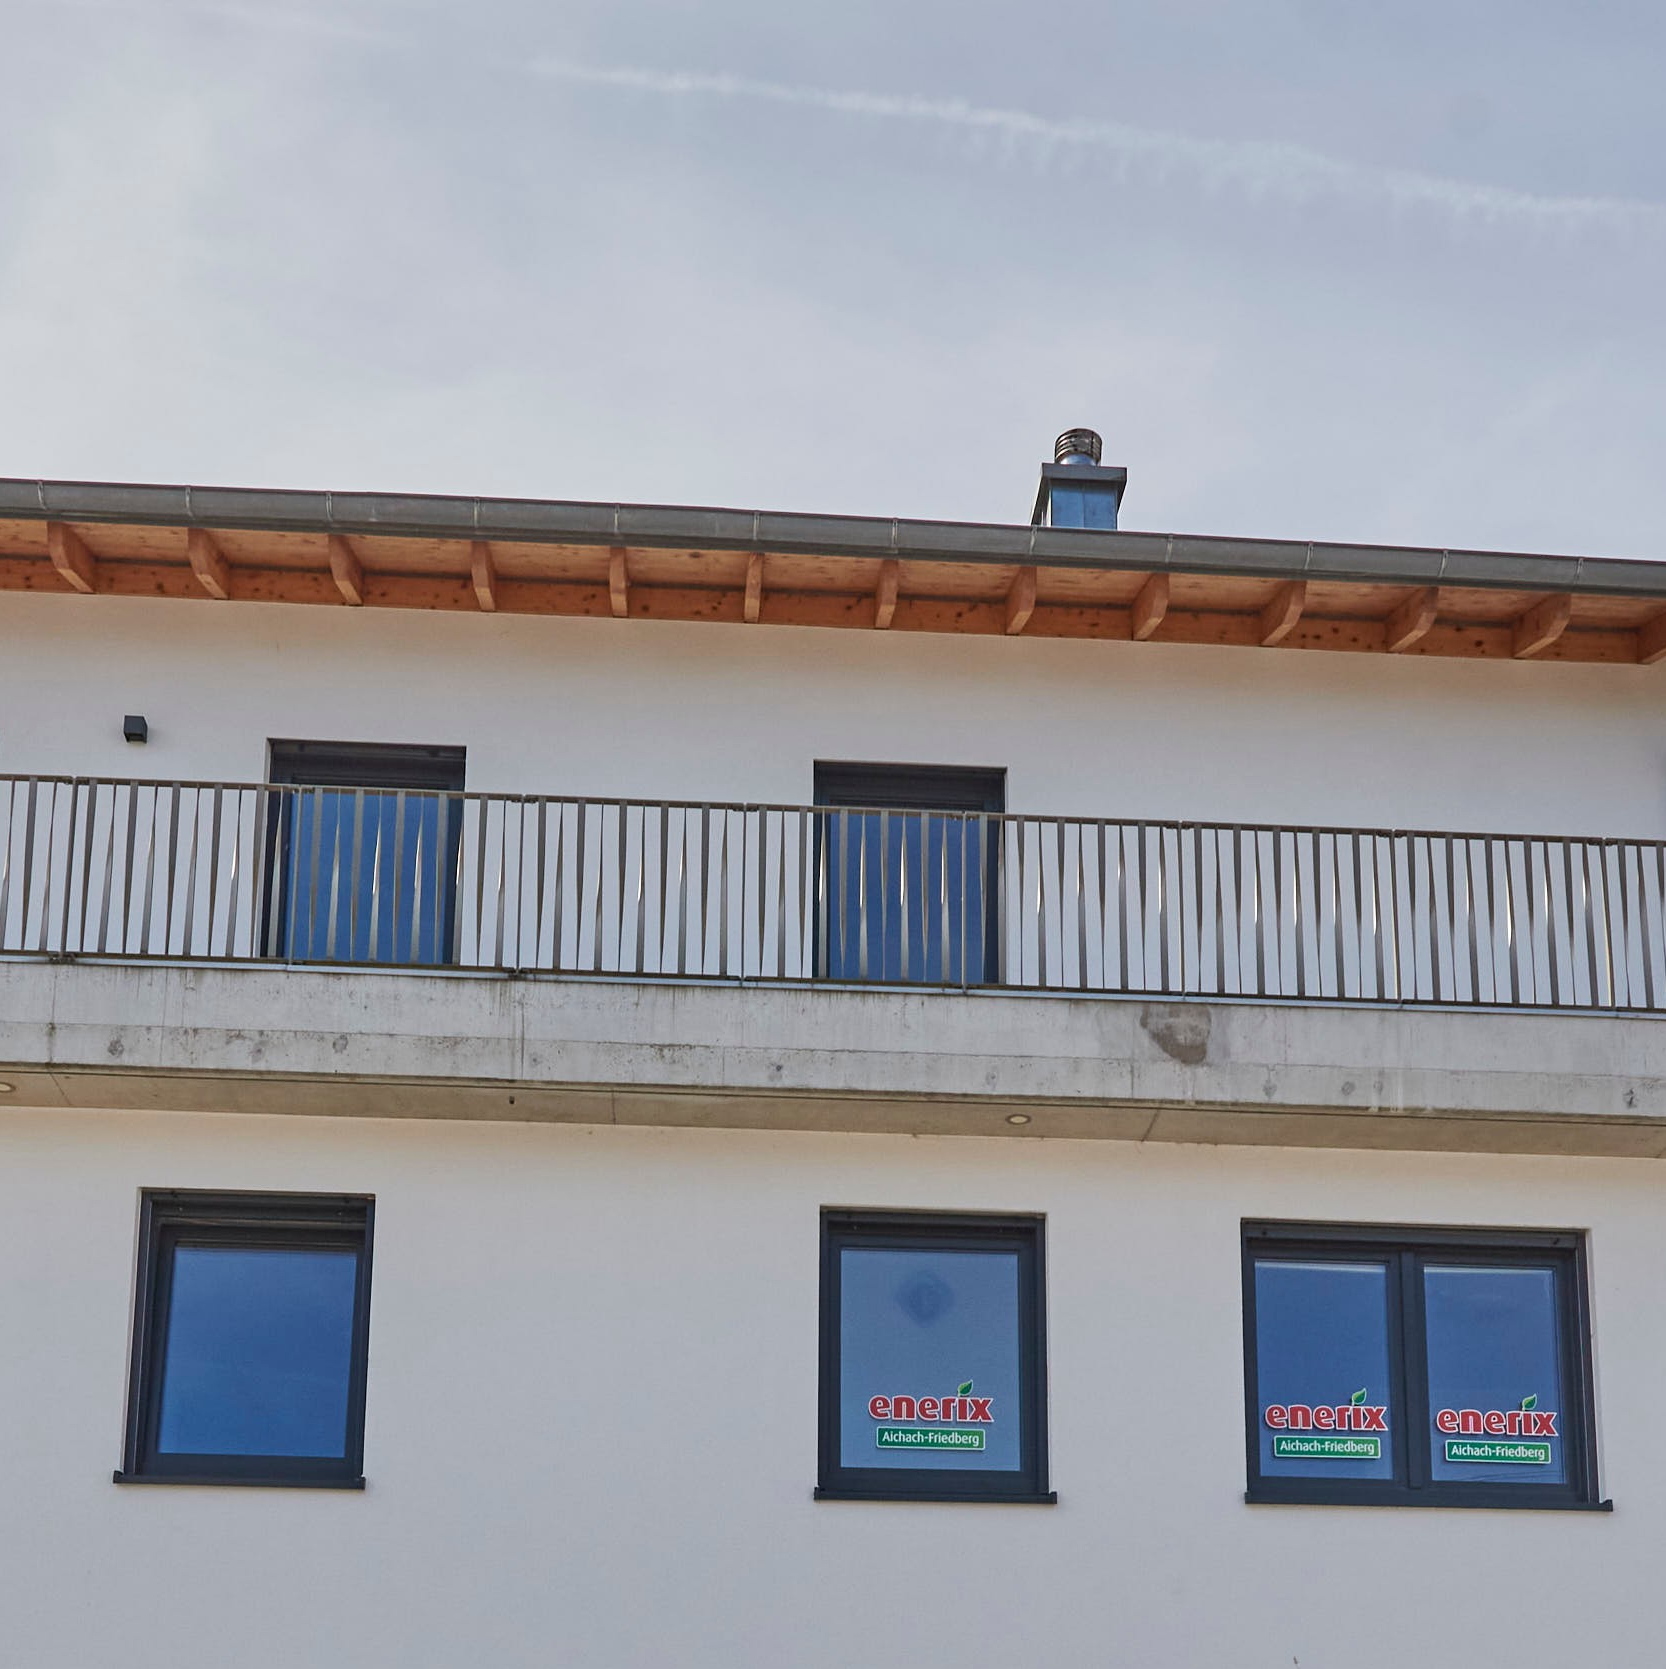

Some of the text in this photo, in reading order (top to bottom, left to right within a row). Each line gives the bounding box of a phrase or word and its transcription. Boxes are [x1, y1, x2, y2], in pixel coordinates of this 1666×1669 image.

[868, 1380, 994, 1422] enerix
[1265, 1388, 1388, 1431] enerix
[1437, 1393, 1558, 1436] enerix
[882, 1430, 980, 1447] Aichach-Friedberg
[1279, 1440, 1375, 1455] Aichach-Friedberg
[1451, 1444, 1546, 1460] Aichach-Friedberg
